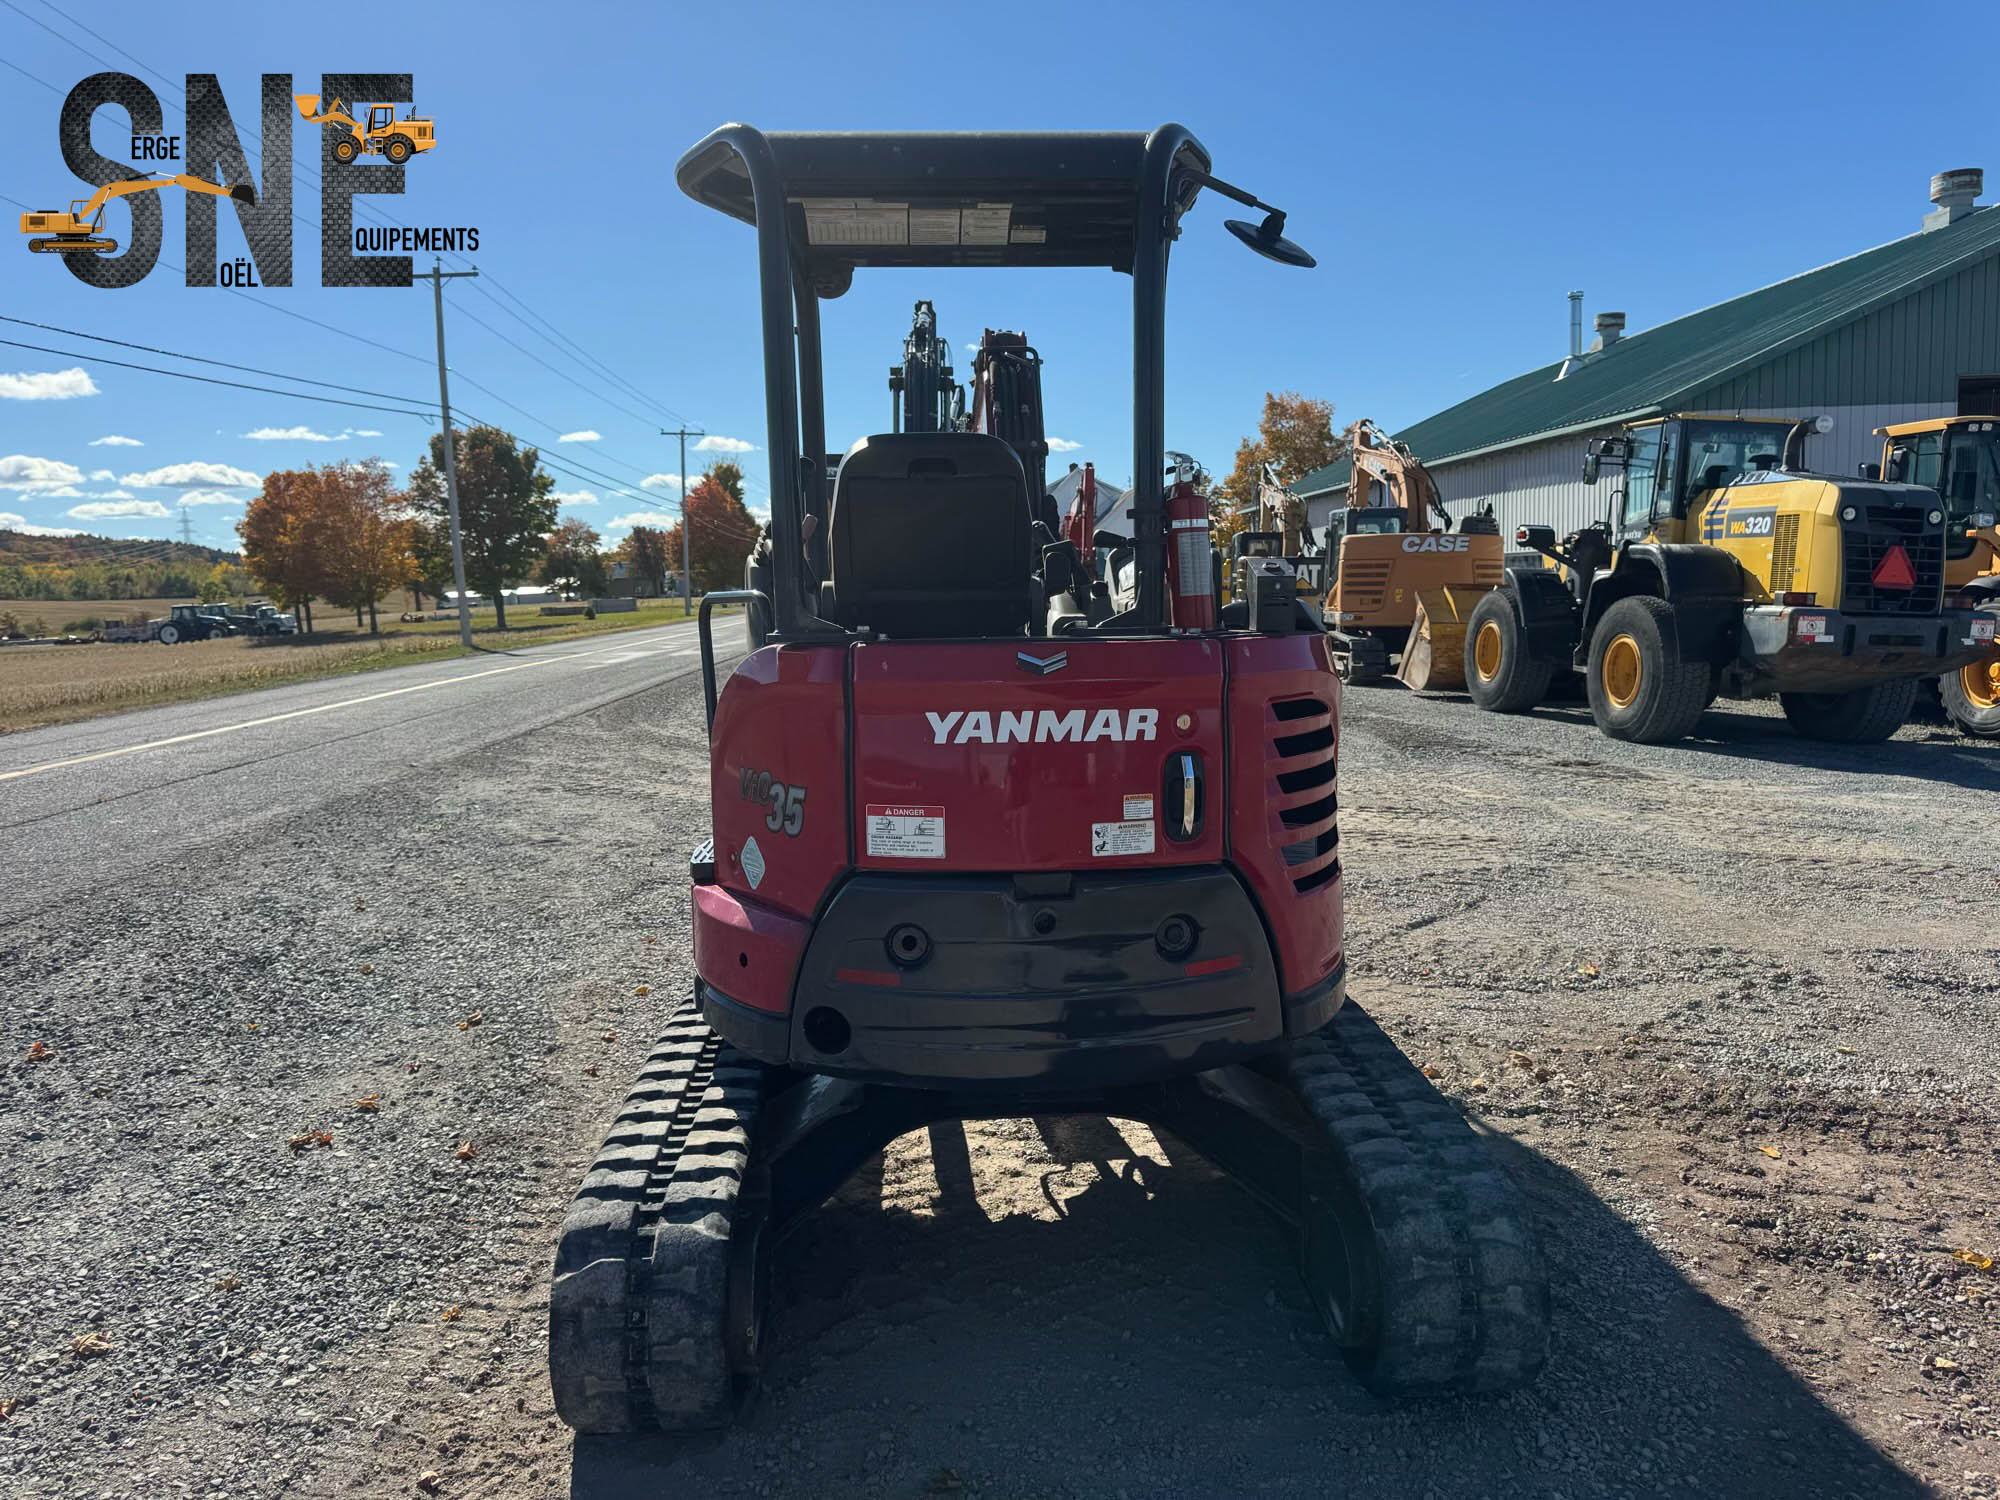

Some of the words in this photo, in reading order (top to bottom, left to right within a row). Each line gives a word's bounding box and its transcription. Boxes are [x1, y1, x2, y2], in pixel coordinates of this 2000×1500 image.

[1730, 516, 1772, 535] WA320
[1402, 536, 1470, 552] CASE
[925, 709, 1158, 744] YANMAR
